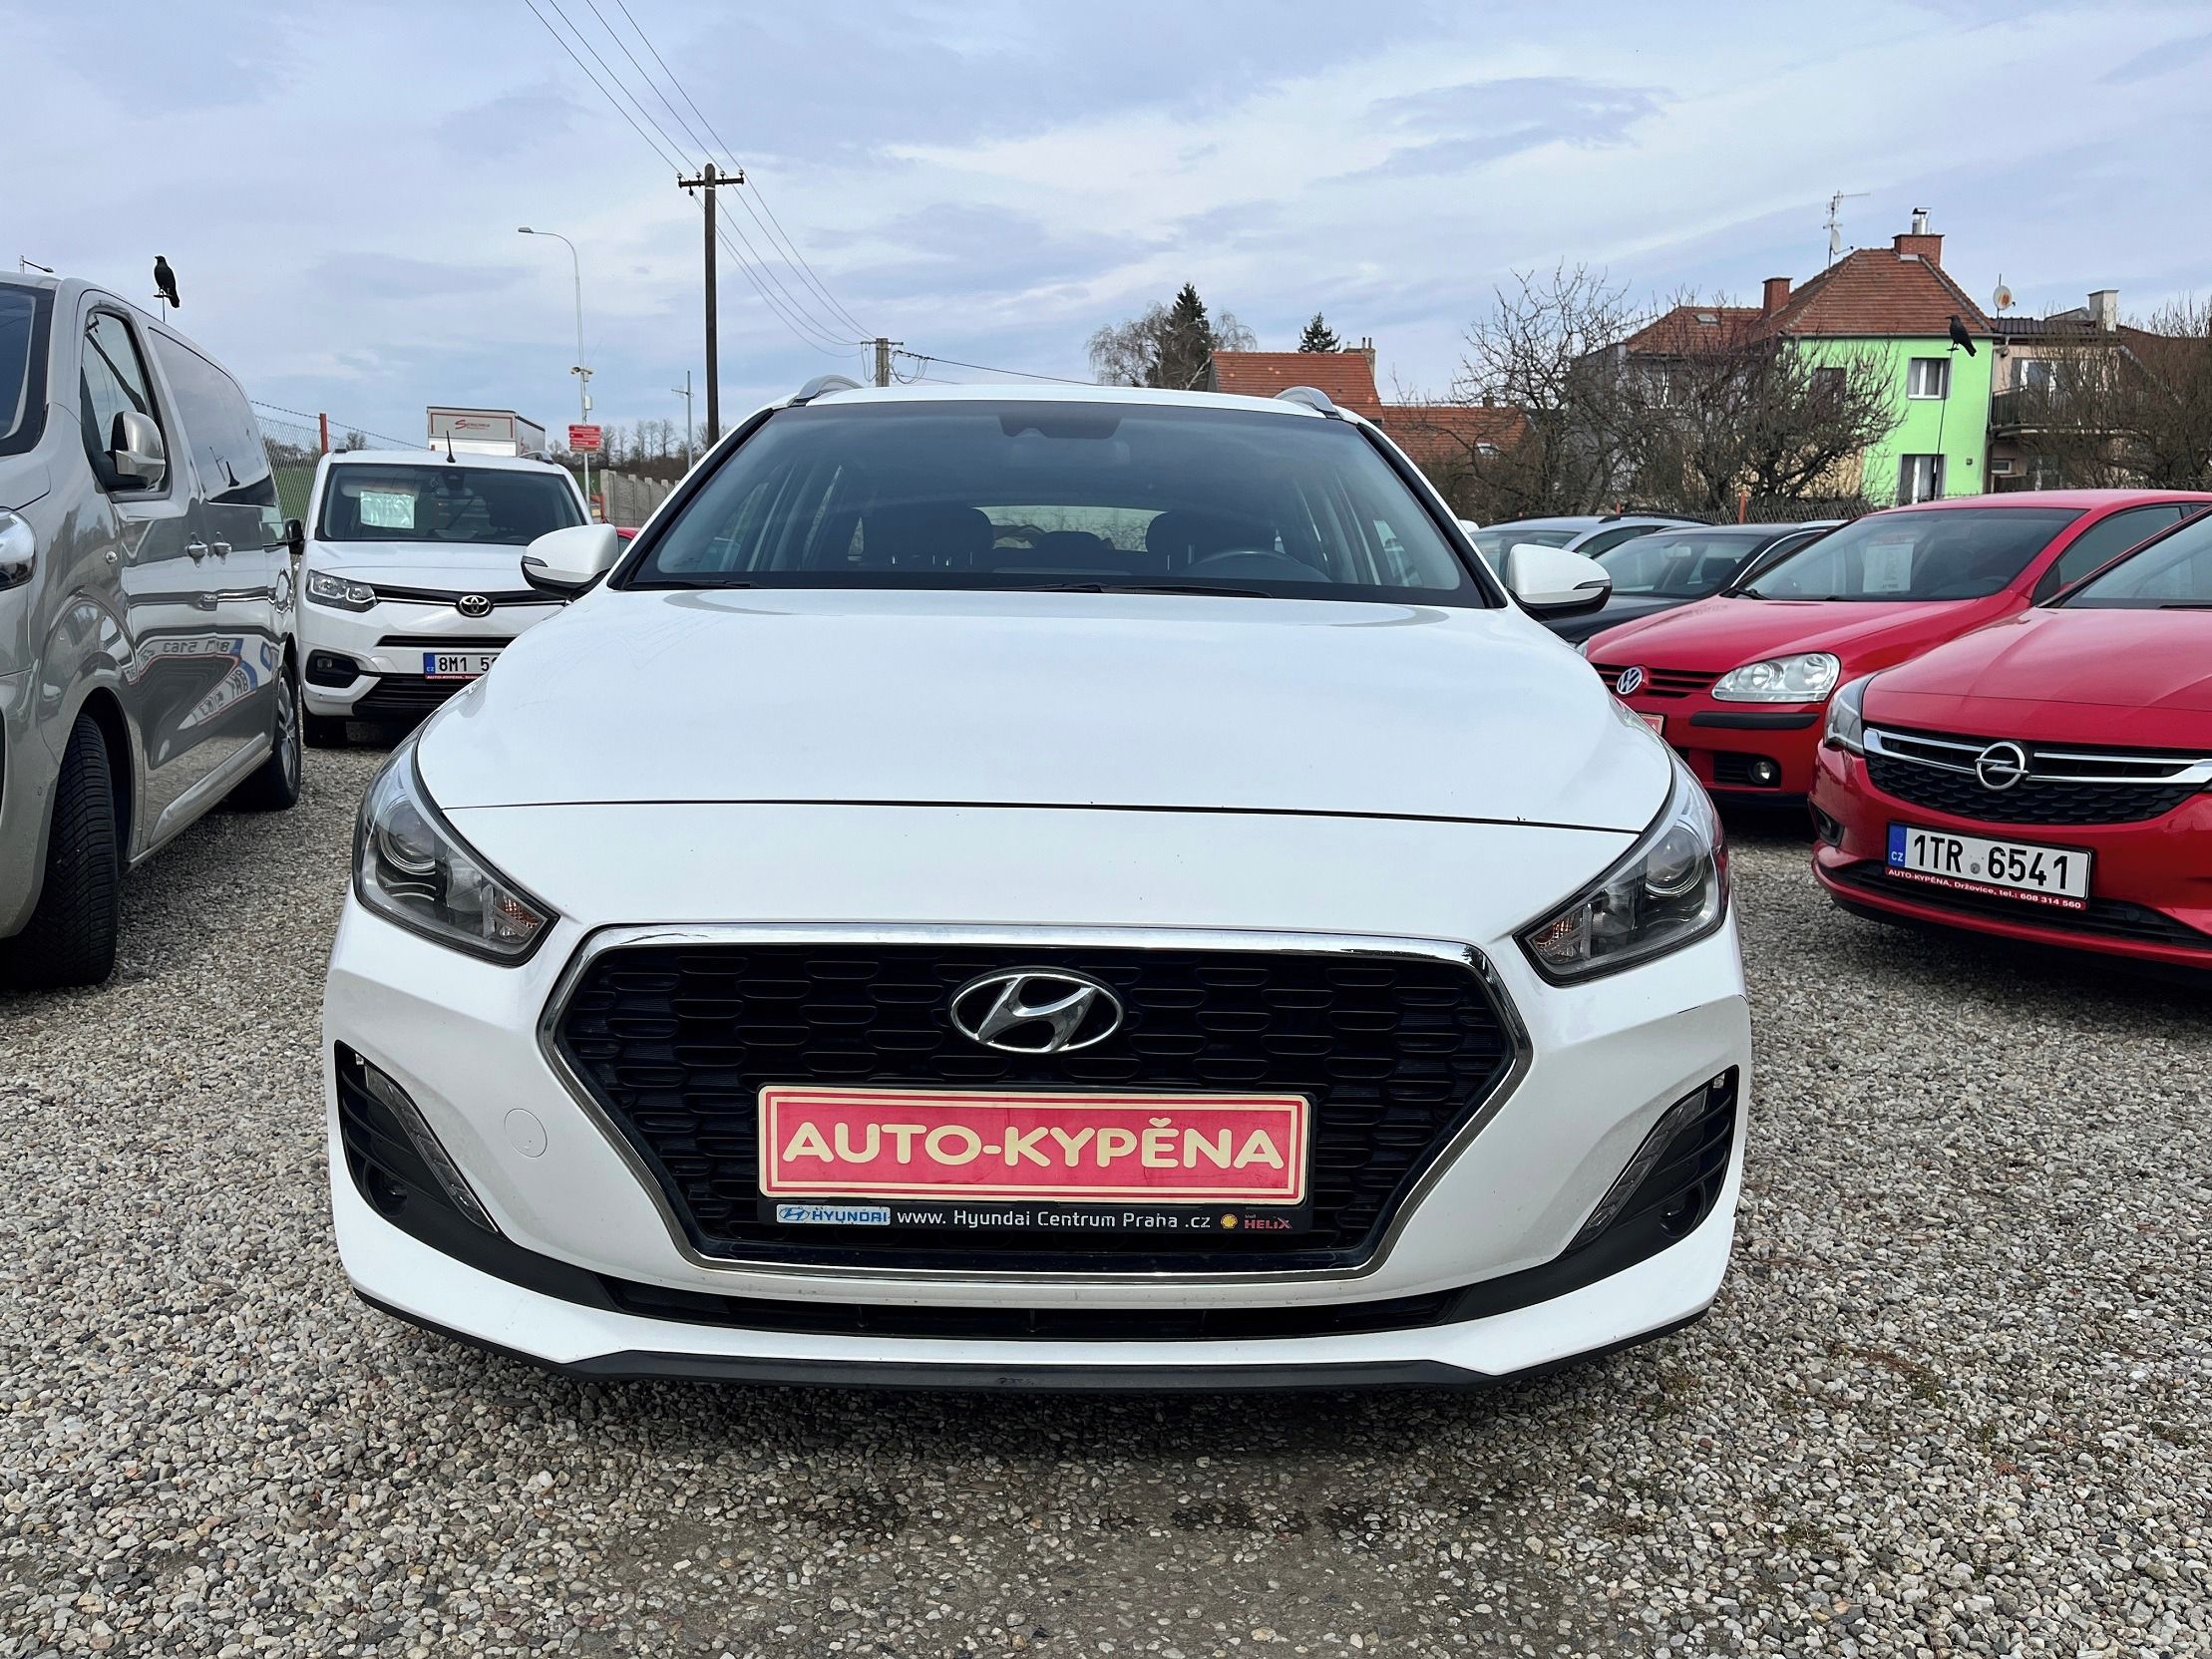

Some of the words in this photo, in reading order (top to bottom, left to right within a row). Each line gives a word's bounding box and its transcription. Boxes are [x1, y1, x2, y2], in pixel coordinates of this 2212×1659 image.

[439, 657, 468, 672] 8M1
[1891, 850, 1904, 862] CZ
[1914, 834, 1964, 873] 1TR
[1988, 845, 2068, 889] 6541
[2020, 892, 2038, 902] 608
[2040, 896, 2059, 905] 314
[2061, 900, 2081, 909] 560
[782, 1117, 1285, 1169] AUTO-KYPĚNA
[812, 1208, 887, 1222] HYUNDAI
[953, 1209, 1030, 1227] Hyundai
[1037, 1211, 1116, 1227] Centrum
[1123, 1212, 1178, 1228] Praha
